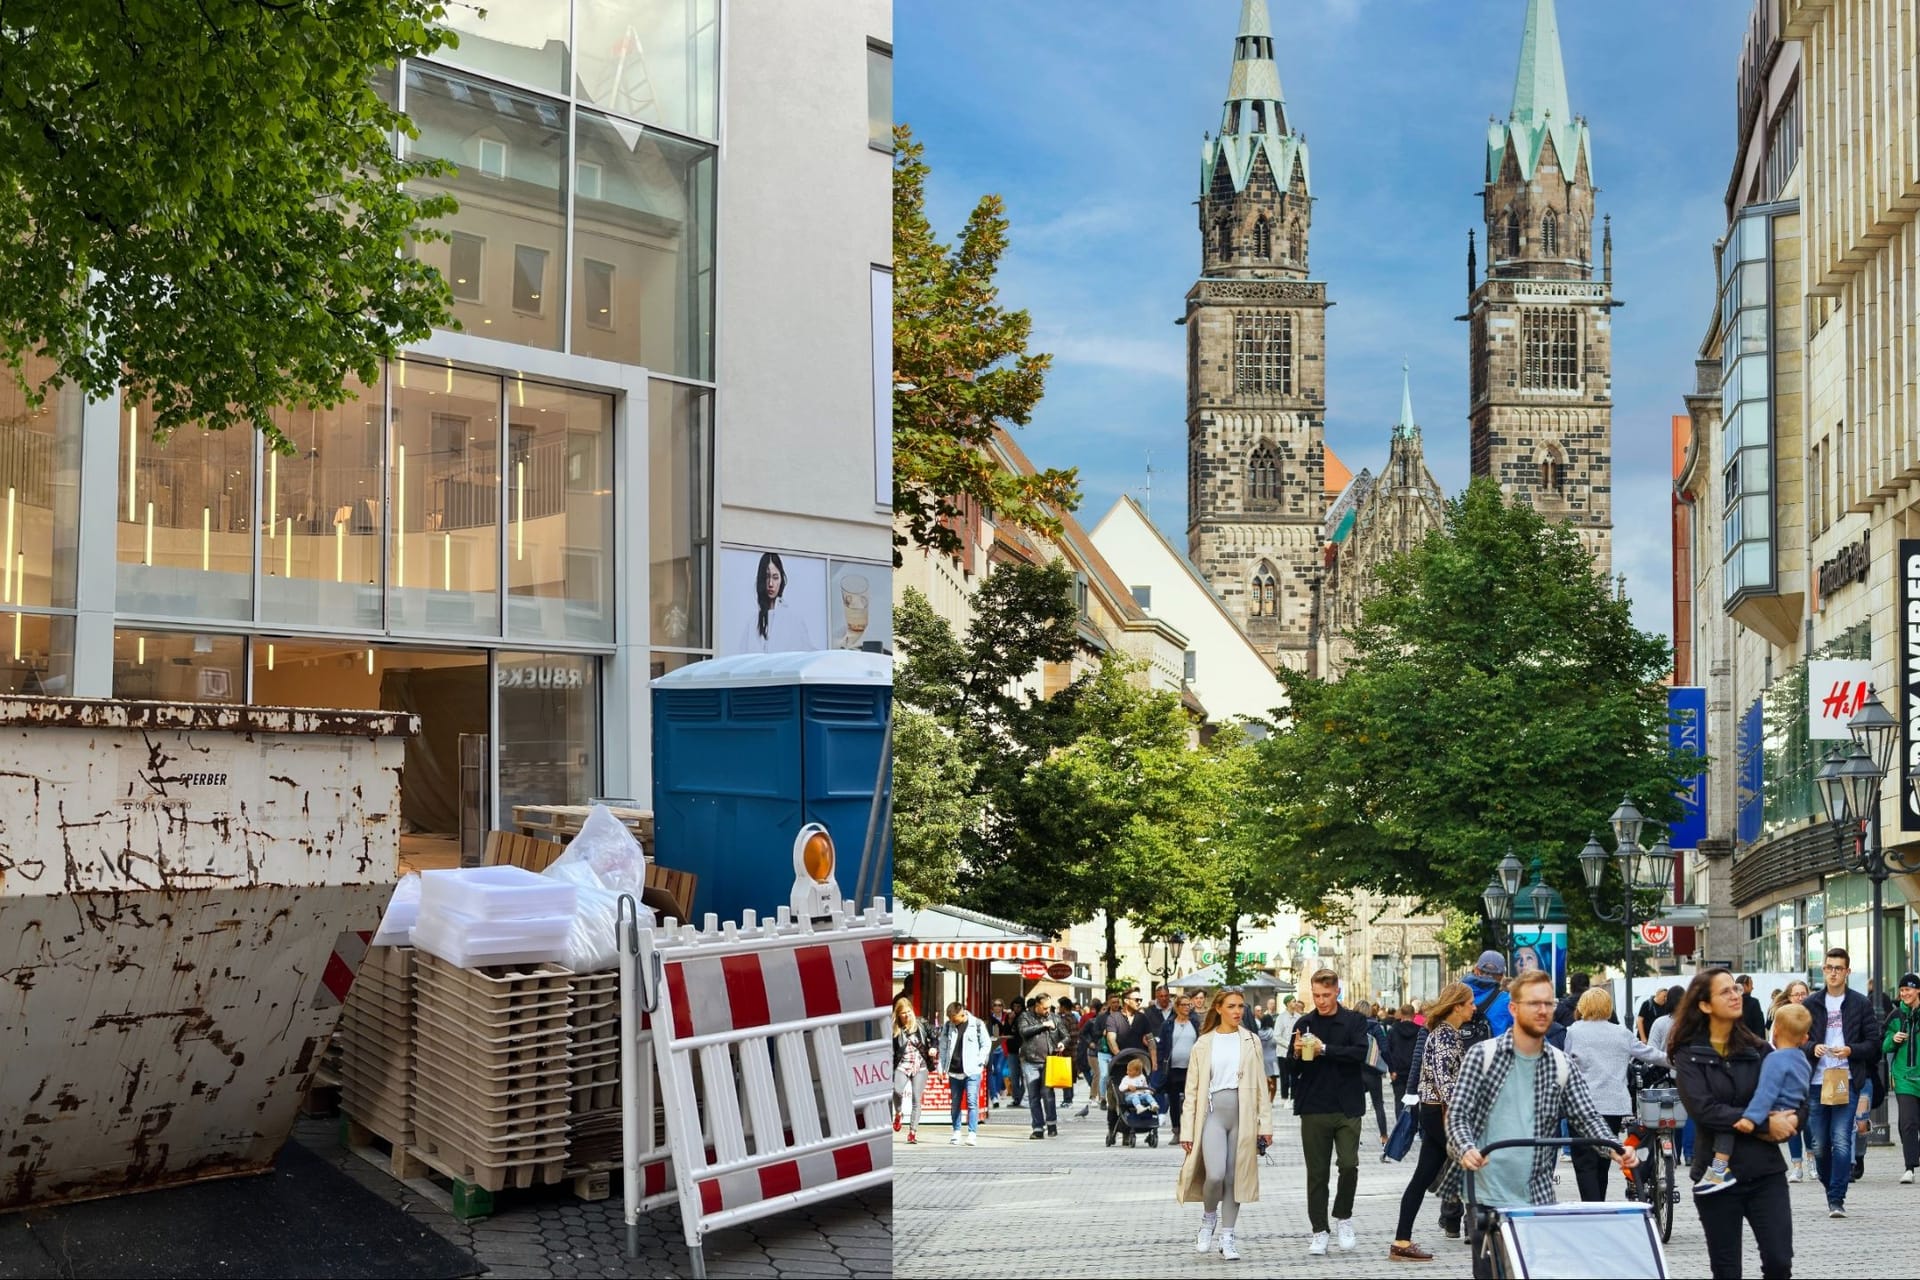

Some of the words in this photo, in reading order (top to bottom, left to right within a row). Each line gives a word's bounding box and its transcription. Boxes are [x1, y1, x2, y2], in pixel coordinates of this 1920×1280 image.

[179, 772, 228, 788] SPERBER
[1202, 952, 1268, 965] CFEE
[852, 1060, 890, 1087] MAC
